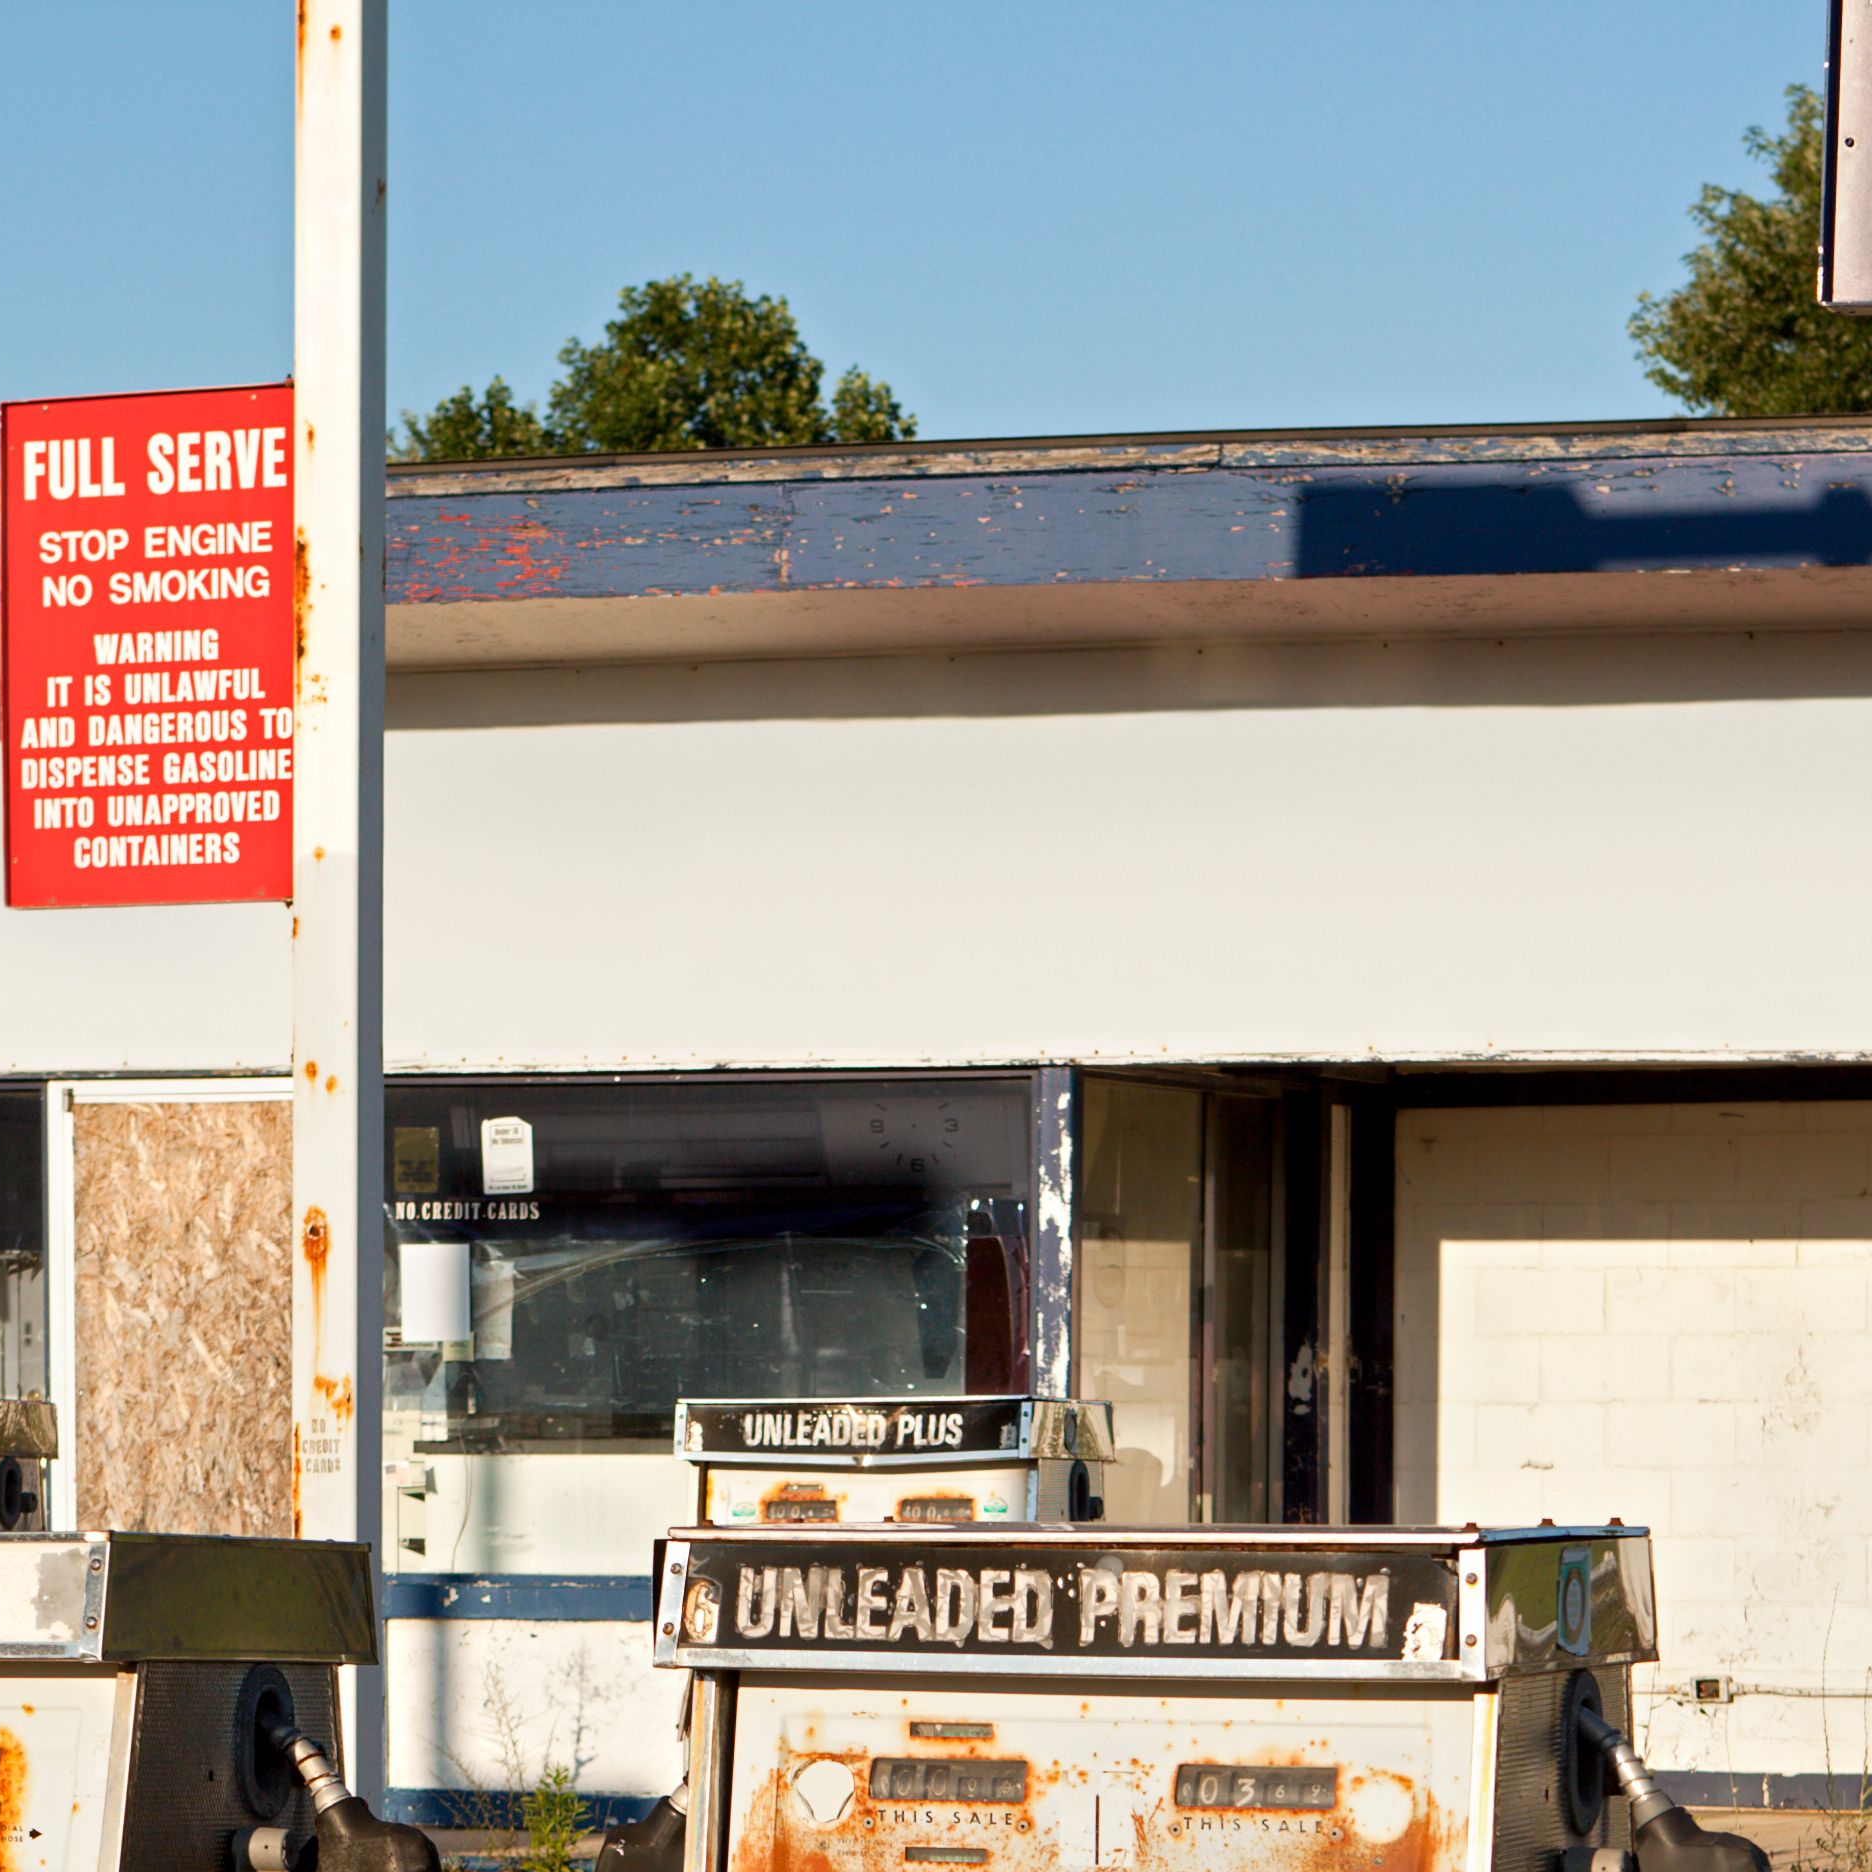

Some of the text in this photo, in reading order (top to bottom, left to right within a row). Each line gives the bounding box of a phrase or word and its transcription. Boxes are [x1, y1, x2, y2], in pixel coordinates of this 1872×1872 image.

[23, 427, 288, 500] FULL SERVE
[39, 521, 273, 563] STOP ENGINE
[43, 565, 270, 607] NO SMOKING
[94, 629, 219, 665] WARNING
[47, 668, 266, 708] IT IS UNLAWFUL
[21, 707, 293, 750] AND DANGEROUS TO
[22, 749, 292, 790] DISPENSE GASOLINE
[34, 790, 280, 829] INTO UNAPPROVED
[74, 832, 239, 868] CONTAINERS
[870, 1119, 884, 1134] 9
[945, 1118, 959, 1132] 3
[911, 1158, 925, 1172] 6
[487, 1201, 540, 1220] CARDS
[311, 1419, 326, 1433] NO
[744, 1412, 886, 1447] UNLEADED
[897, 1413, 963, 1447] PLUS
[302, 1439, 341, 1454] CREDIT
[306, 1458, 341, 1473] CARDS
[736, 1566, 1054, 1648] UNLEADED
[1079, 1567, 1390, 1648] PREMIUM
[878, 1810, 1012, 1825] THIS SALE
[1184, 1816, 1322, 1833] THIS SALE
